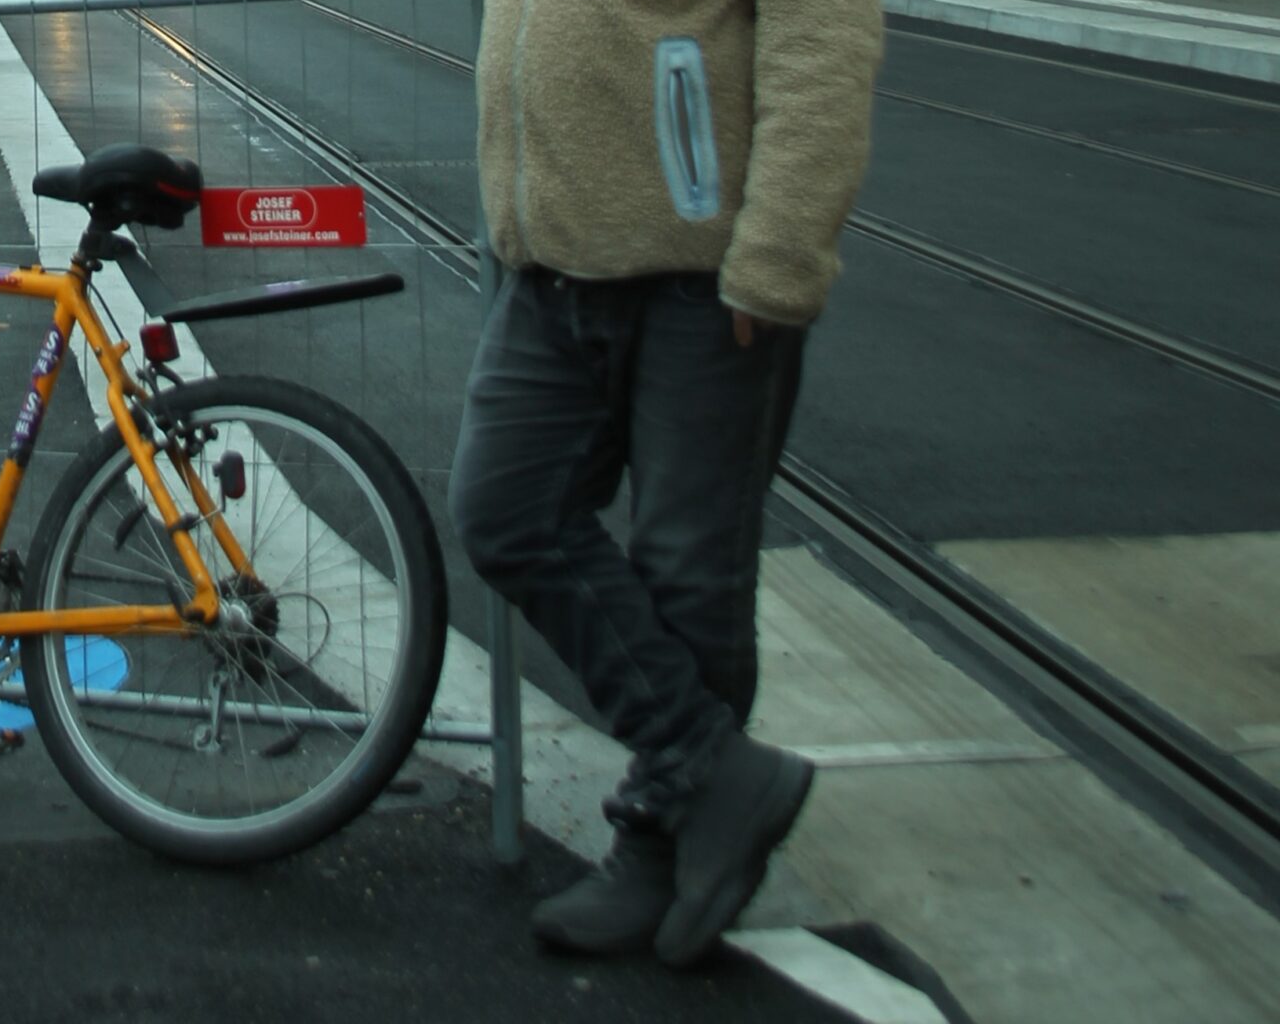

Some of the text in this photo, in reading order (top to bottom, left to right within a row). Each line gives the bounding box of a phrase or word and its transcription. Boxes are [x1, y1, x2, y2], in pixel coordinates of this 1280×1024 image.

[256, 197, 293, 209] JOSEF
[250, 209, 301, 222] STEINER
[223, 230, 340, 243] www.josefsteiner.com
